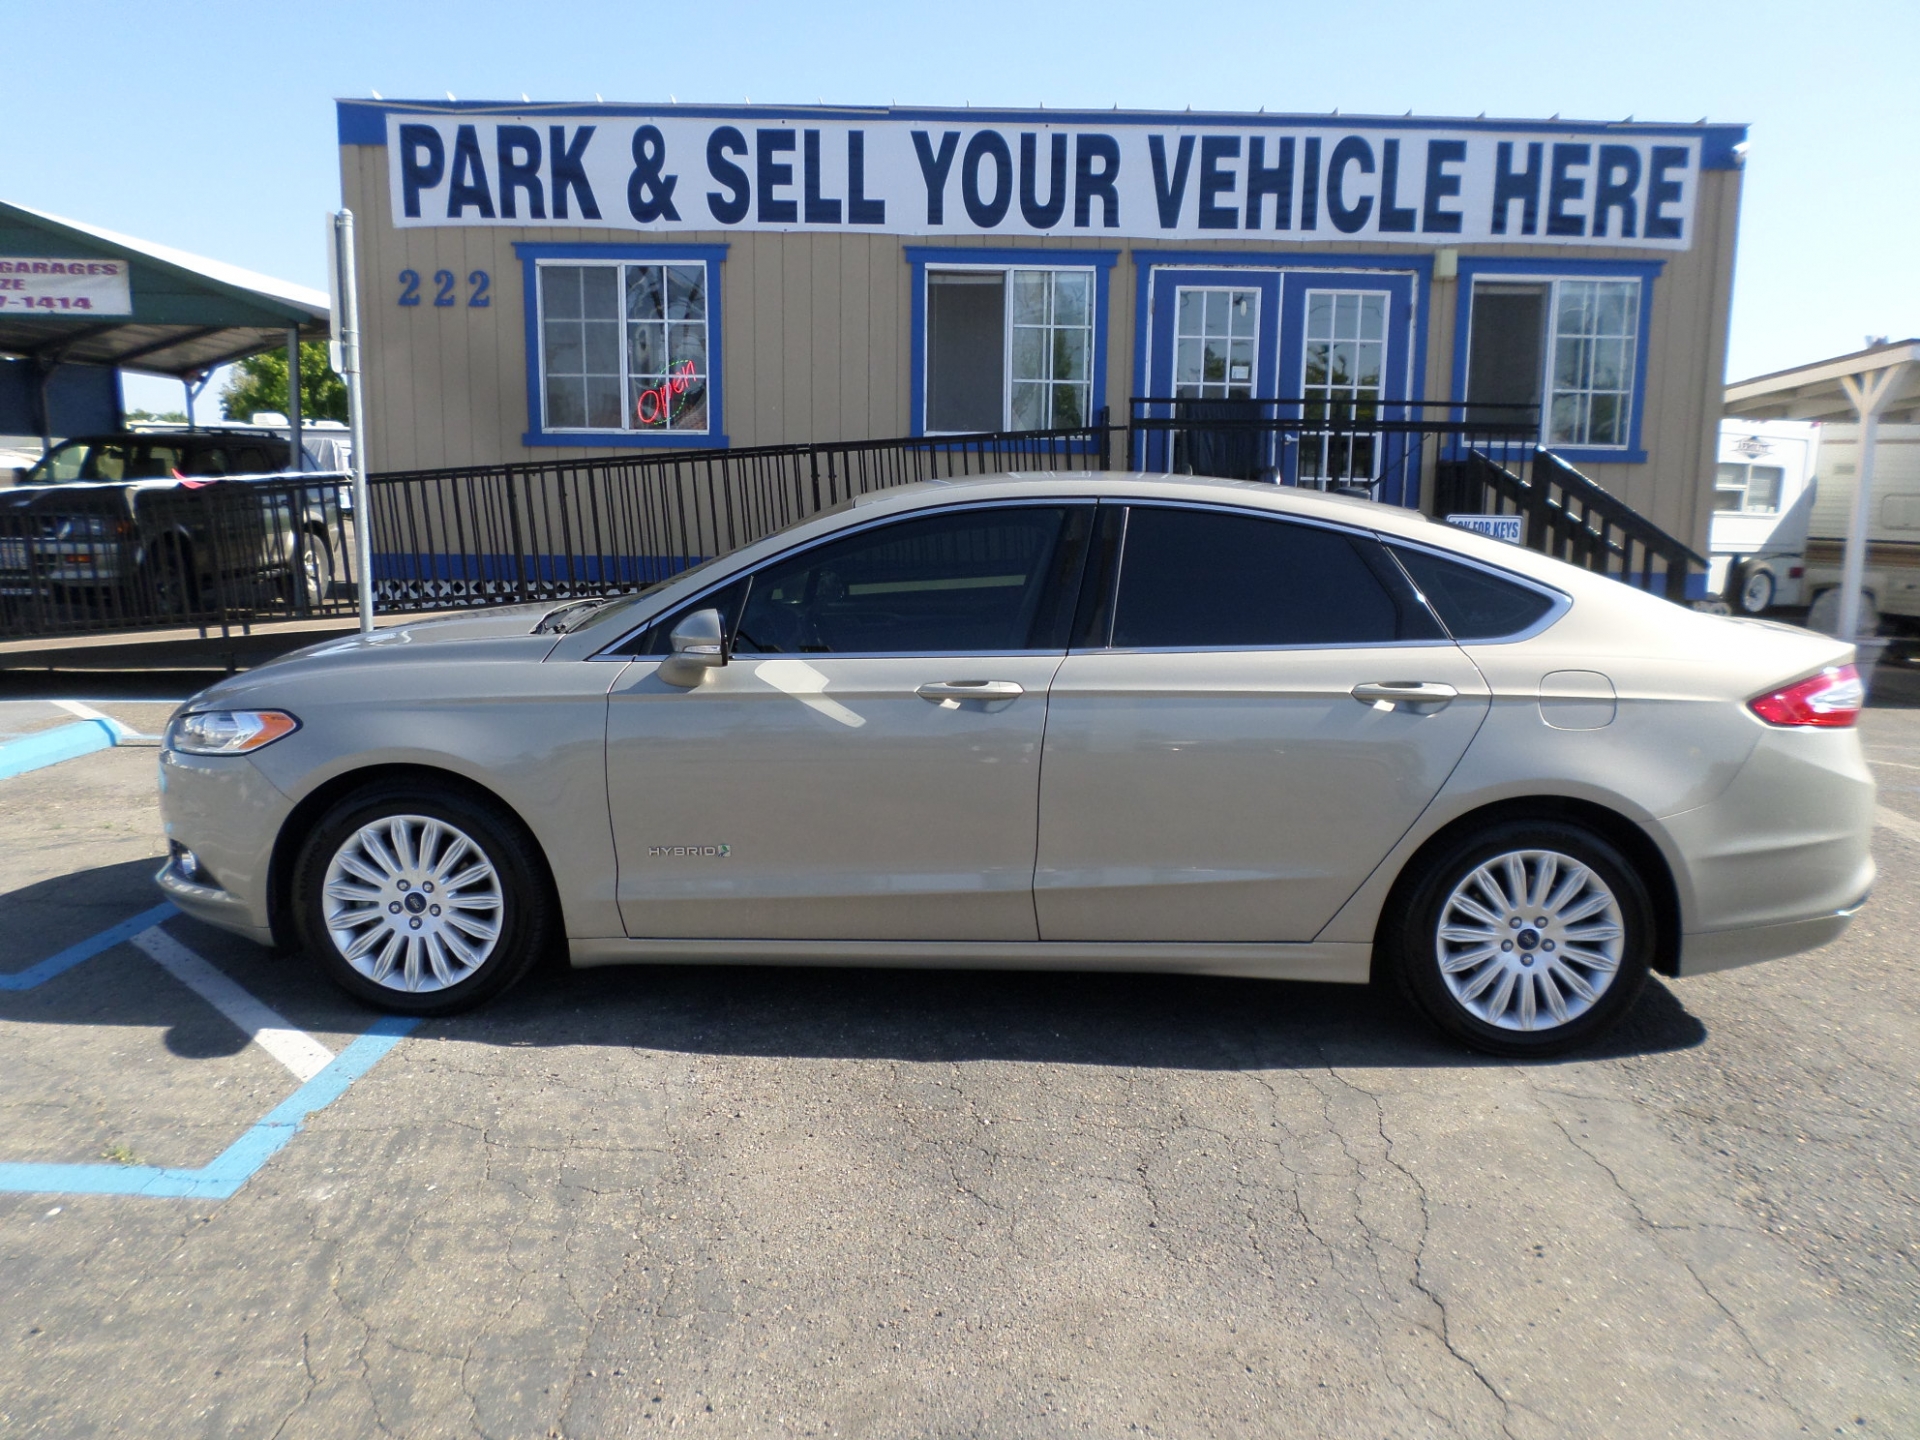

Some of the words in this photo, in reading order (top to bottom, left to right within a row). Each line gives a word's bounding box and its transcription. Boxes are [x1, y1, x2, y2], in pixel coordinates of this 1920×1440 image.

[399, 123, 603, 220] PARK
[626, 124, 682, 223] &
[705, 125, 886, 225] SELL
[910, 129, 1121, 229] YOUR
[1148, 134, 1467, 233] VEHICLE
[1491, 140, 1691, 240] HERE
[0, 261, 118, 276] GARAGES
[637, 359, 697, 423] Open
[1493, 521, 1519, 539] KEYS
[648, 846, 716, 856] HYBRID
